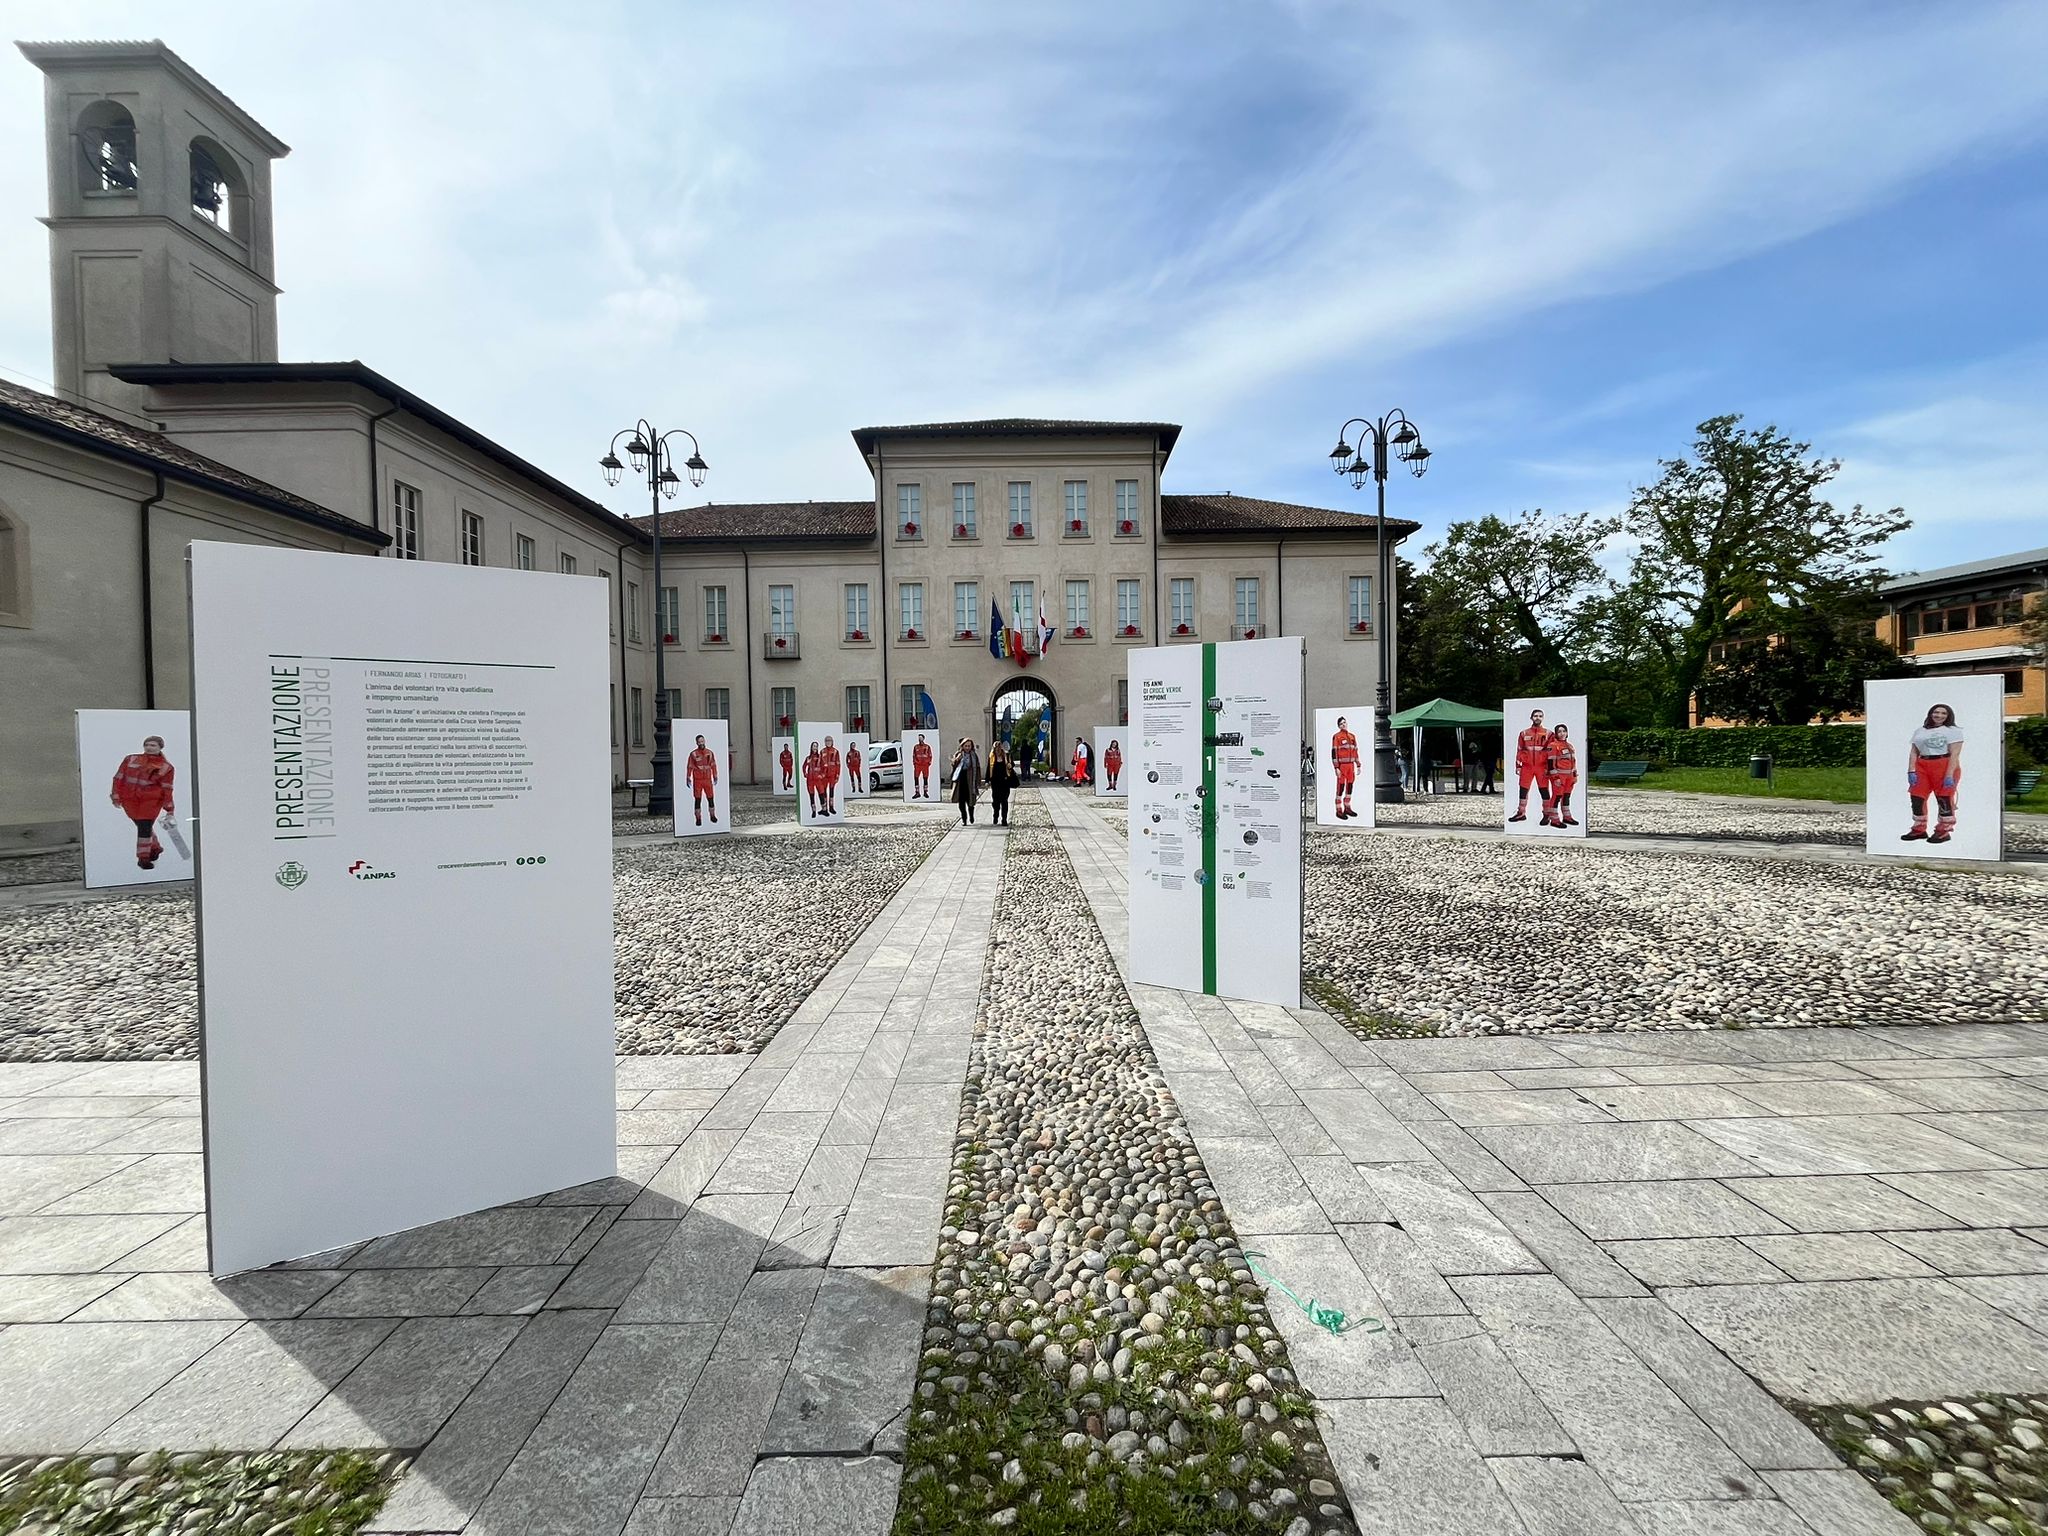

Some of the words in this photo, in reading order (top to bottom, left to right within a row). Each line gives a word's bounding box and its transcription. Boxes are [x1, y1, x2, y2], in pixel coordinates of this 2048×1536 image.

[405, 684, 434, 692] volontari
[460, 686, 494, 694] quotidiana
[372, 694, 402, 702] impegno
[271, 665, 304, 828] PRESENTAZIONE
[303, 667, 335, 827] PRESENTAZIONE
[362, 872, 396, 880] ANPAS
